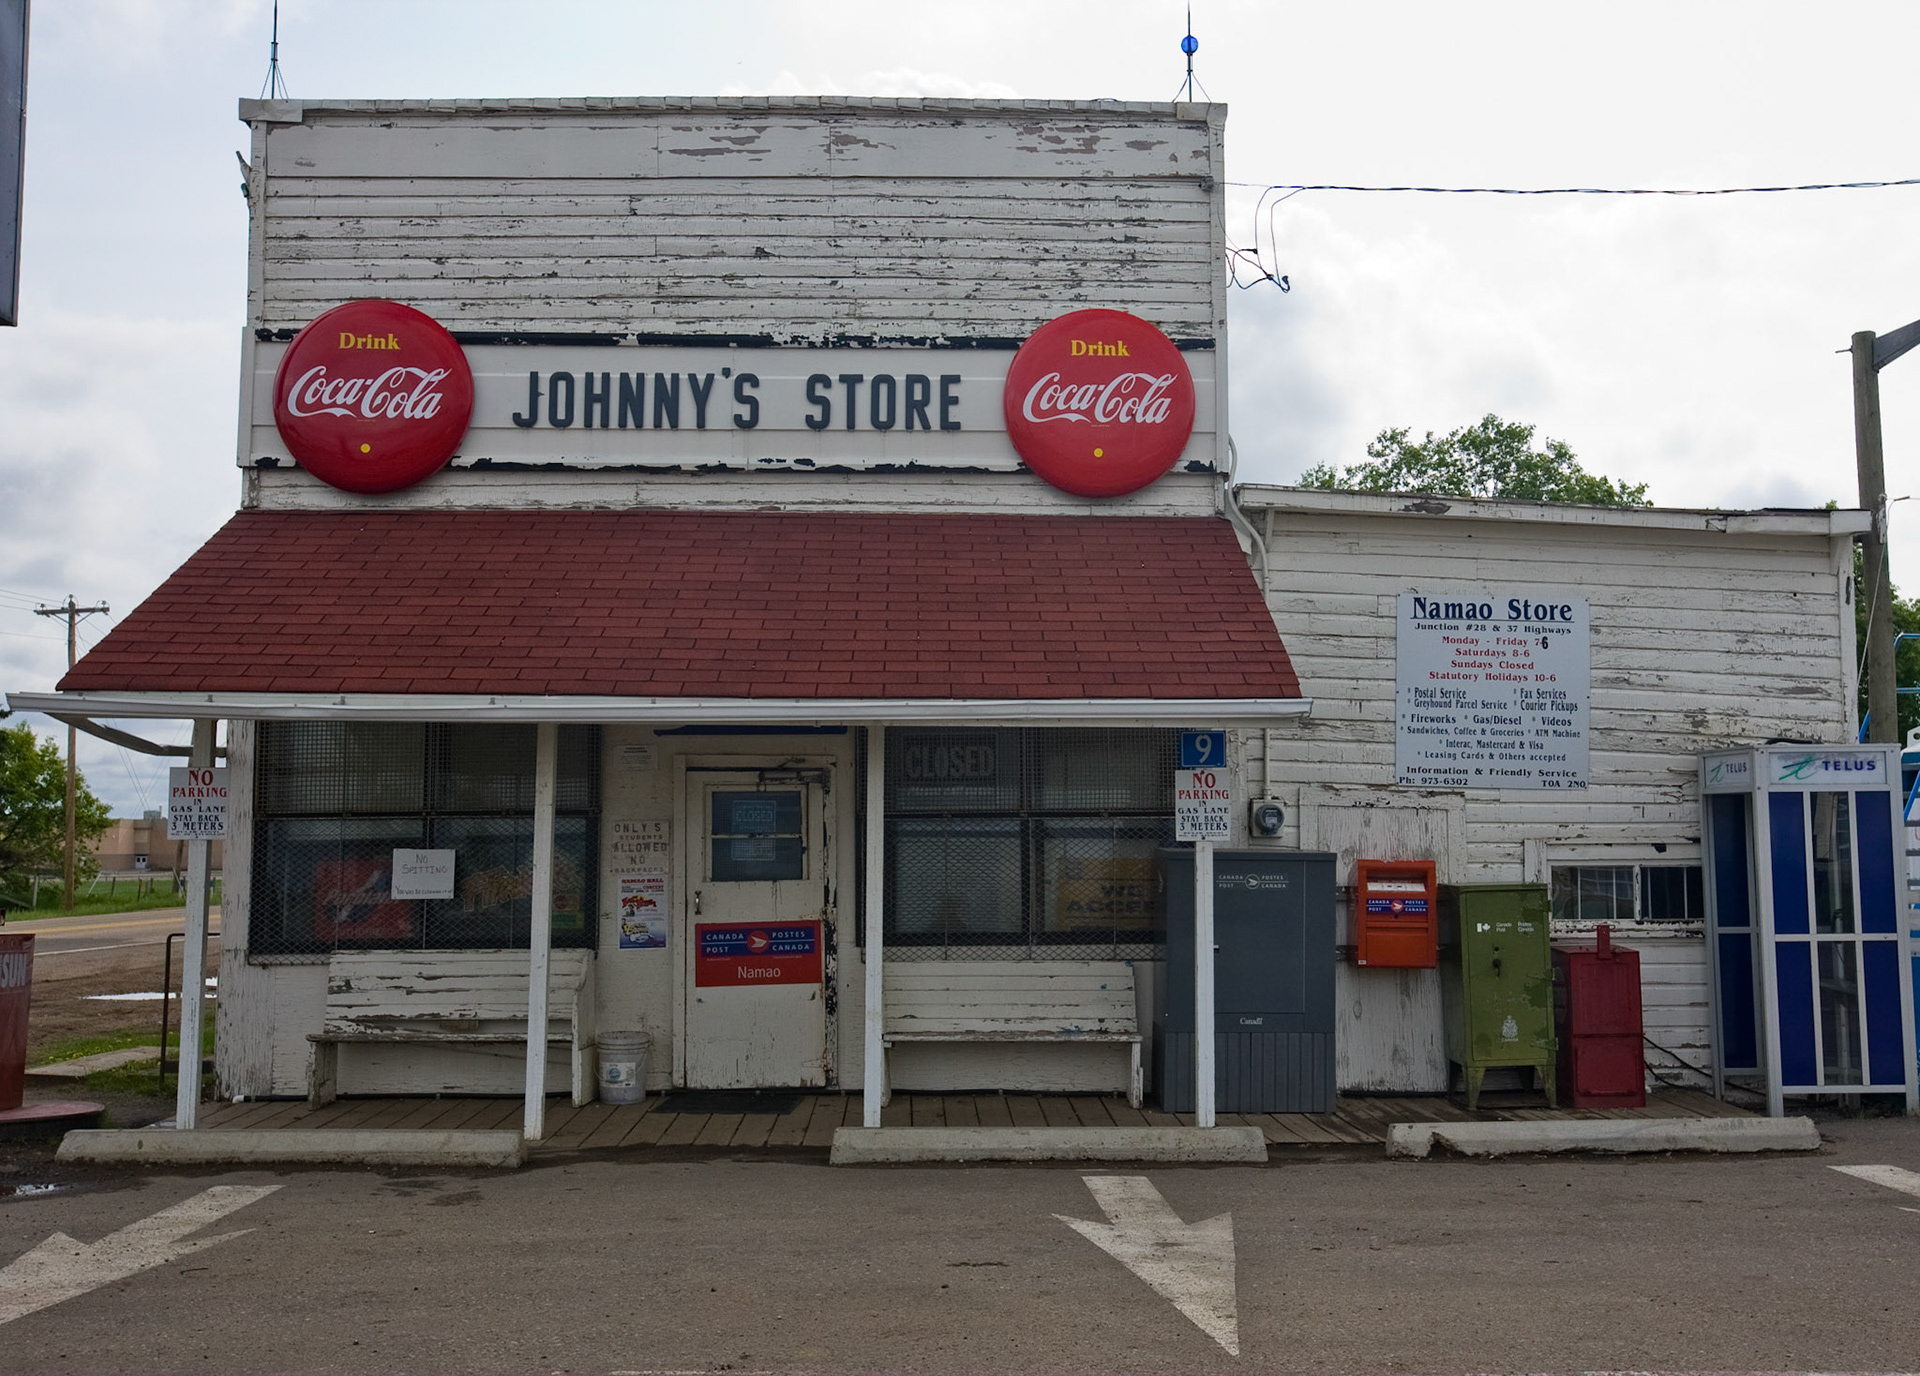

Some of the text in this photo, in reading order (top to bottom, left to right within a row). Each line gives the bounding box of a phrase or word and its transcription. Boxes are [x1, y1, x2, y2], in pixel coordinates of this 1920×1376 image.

[339, 332, 401, 350] Drink
[1071, 339, 1130, 357] Drink
[287, 365, 453, 420] Coca-Cola
[1023, 371, 1179, 424] Coca-Cola
[512, 367, 961, 431] JOHNNY'S STORE
[1413, 597, 1572, 621] Namao Store
[1415, 622, 1572, 635] Junction #28 & 37 Highways
[1442, 636, 1480, 647] Monday
[1496, 637, 1528, 647] Friday
[1455, 648, 1530, 658] Saturdays 8-6
[1451, 660, 1534, 671] Sundays Closed
[1429, 672, 1557, 682] Statutory Holidays 10-6
[1414, 687, 1467, 699] Postal Service
[1520, 688, 1567, 700] Fax Services
[1414, 699, 1507, 710] Greyhound Parcel Service
[1520, 700, 1578, 714] Courier Pickups
[1411, 713, 1456, 723] Fireworks
[1472, 714, 1522, 725] Gas/Diesel
[1541, 716, 1572, 726] Videos
[1407, 726, 1524, 737] Sandwiches, Coffee & Groceries
[1535, 729, 1581, 738] ATM Machine
[1195, 734, 1212, 764] 9
[1445, 739, 1544, 750] Interac, Mastercard & Visa
[905, 745, 995, 778] CLOSED
[1425, 751, 1566, 763] Leasing Cards & Others accepted
[1726, 762, 1747, 773] TELUS
[1822, 760, 1876, 771] TELUS
[188, 769, 214, 786] NO
[1406, 766, 1469, 775] Information
[1489, 768, 1532, 778] Friendly
[1538, 769, 1577, 778] Service
[1192, 772, 1216, 789] NO
[1399, 776, 1469, 786] Ph: 973-6302
[172, 787, 228, 798] PARKING
[1178, 789, 1230, 800] PARKING
[193, 798, 203, 806] IN
[170, 805, 227, 813] GAS LANE
[173, 814, 220, 822] STAY BACK
[1181, 815, 1224, 823] STAY BACK
[171, 822, 224, 831] 3 METERS
[614, 823, 647, 833] ONLY
[1179, 822, 1228, 831] 3 METERS
[613, 842, 667, 853] ALLOWED
[415, 853, 428, 864] NO
[630, 855, 646, 865] NO
[401, 863, 448, 875] SPITTING
[706, 932, 745, 941] CANADA
[772, 930, 806, 938] POSTES
[706, 946, 729, 954] POST
[772, 943, 810, 951] CANADA
[737, 966, 781, 979] Namao
[1239, 1017, 1263, 1025] Canada
